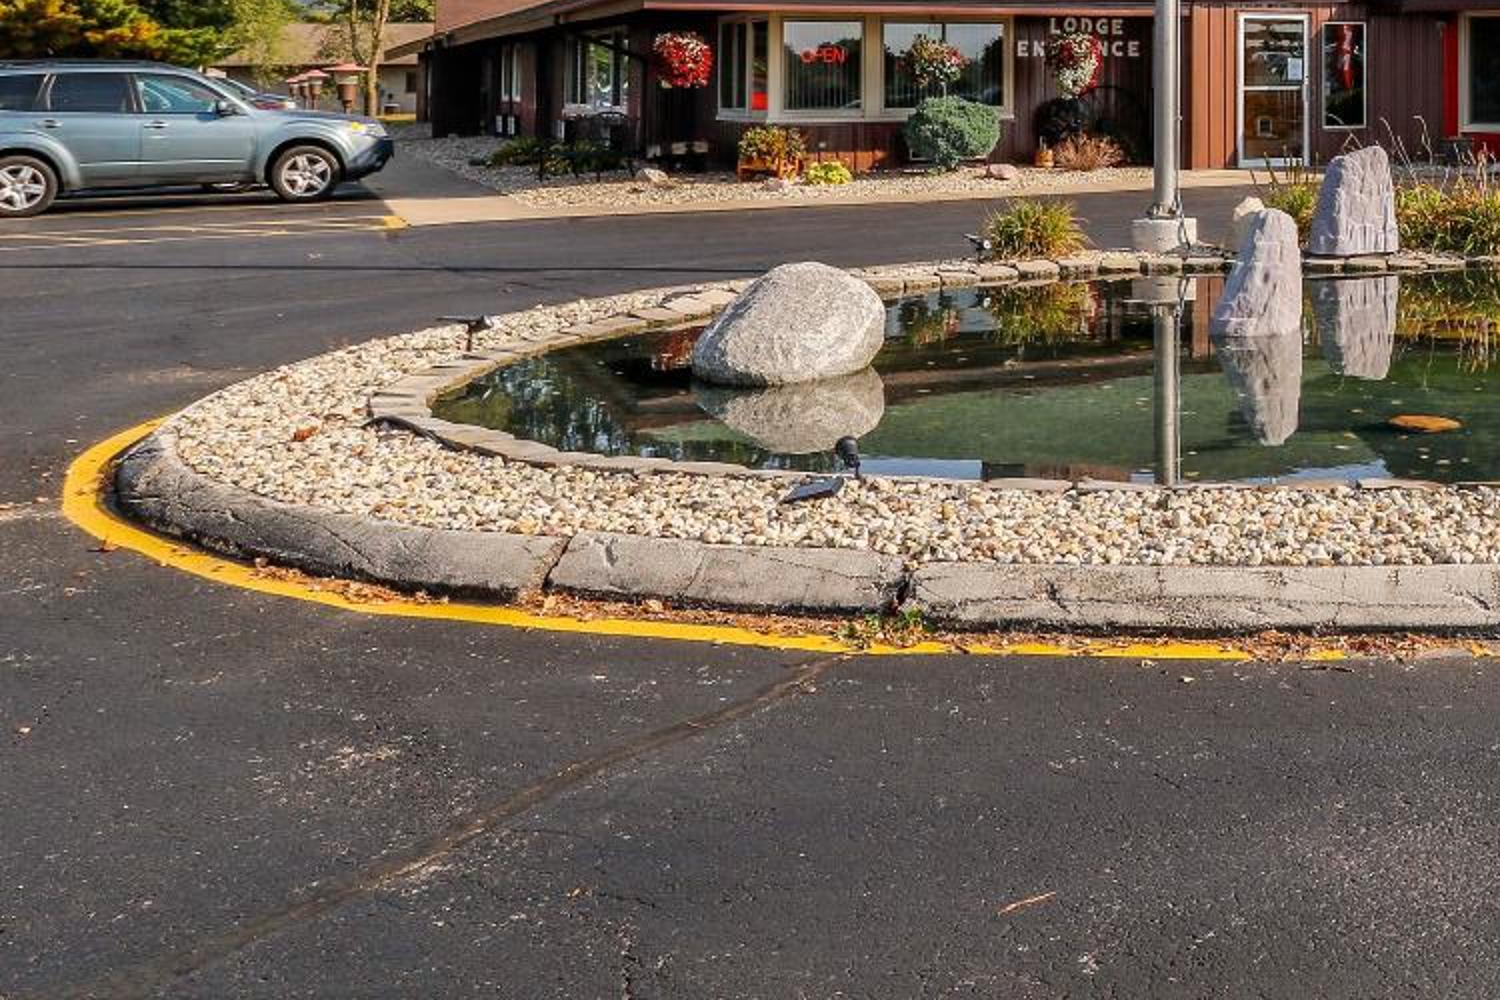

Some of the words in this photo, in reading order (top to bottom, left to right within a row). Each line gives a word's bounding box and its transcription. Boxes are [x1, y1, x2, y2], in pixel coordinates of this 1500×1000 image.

[1049, 17, 1123, 35] LODGE
[800, 47, 845, 63] OPEN
[1017, 40, 1140, 57] ENNCE
